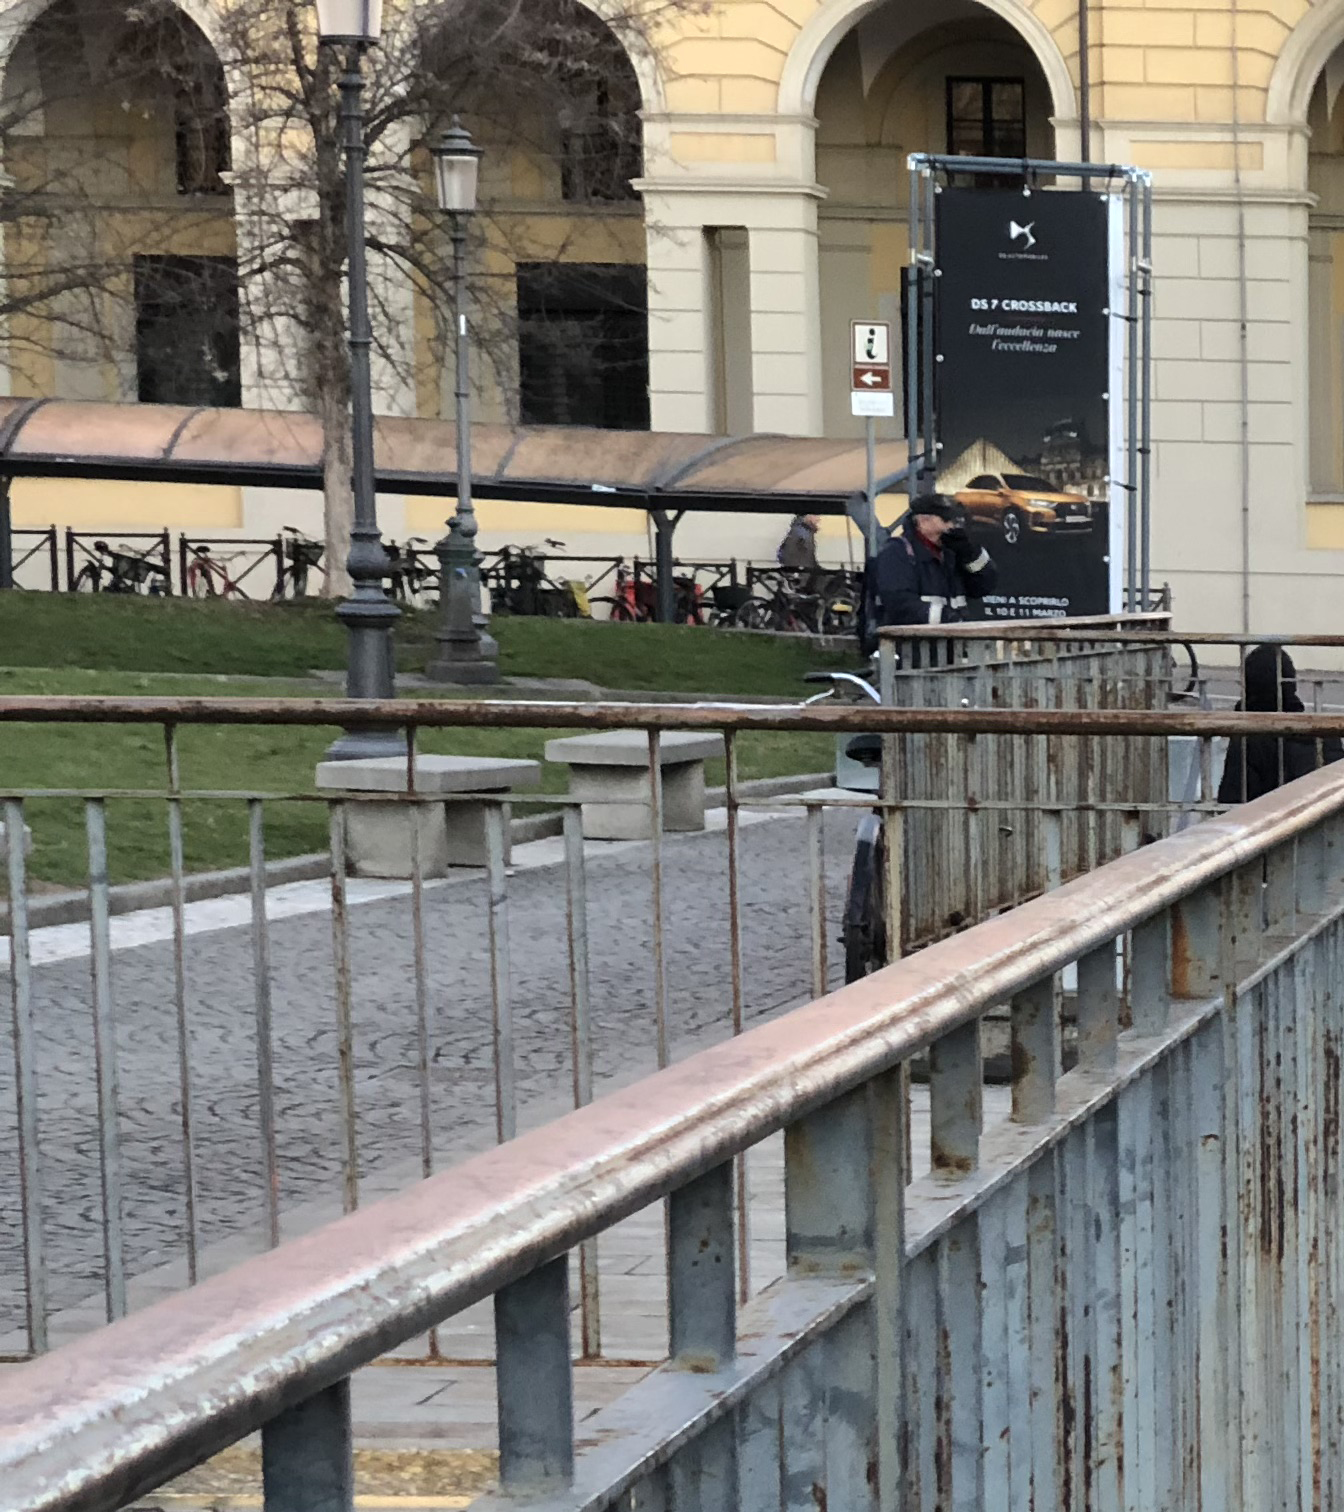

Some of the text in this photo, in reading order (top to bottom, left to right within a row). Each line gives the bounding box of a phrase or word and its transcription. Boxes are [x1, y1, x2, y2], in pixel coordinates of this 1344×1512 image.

[971, 298, 1077, 313] DS 7 CROSSBACK
[1047, 328, 1080, 338] nasce
[1008, 596, 1017, 604] A
